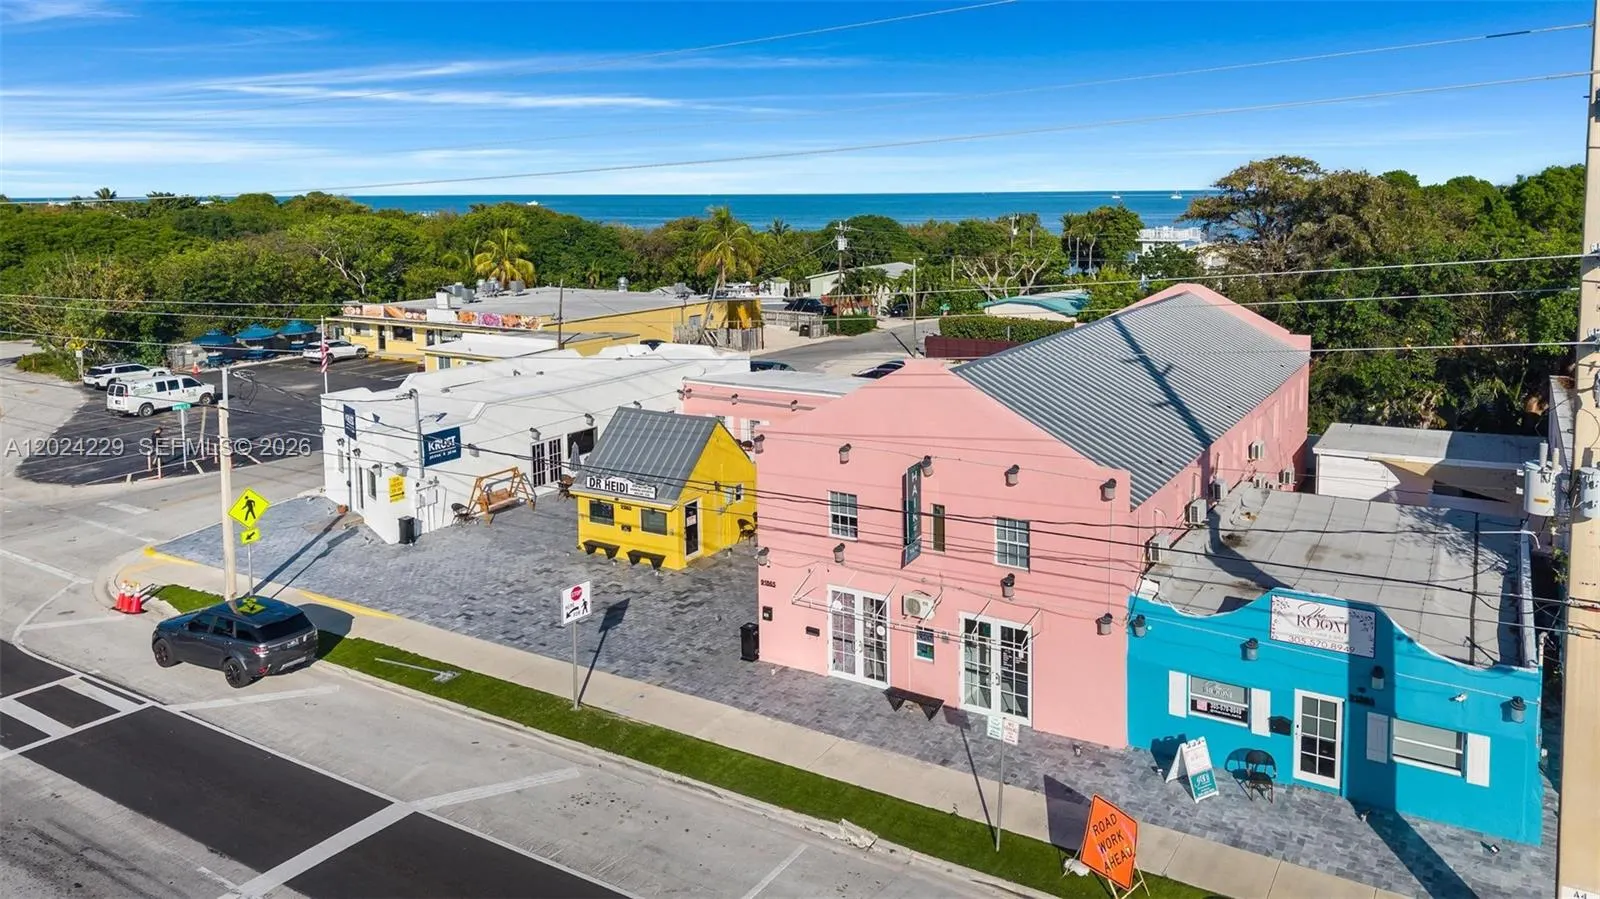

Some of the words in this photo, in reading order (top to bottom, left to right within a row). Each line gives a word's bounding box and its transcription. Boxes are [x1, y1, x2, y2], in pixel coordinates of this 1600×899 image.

[428, 436, 456, 451] KRUST
[589, 477, 602, 489] DR
[604, 479, 629, 494] HEIDI
[1296, 614, 1348, 634] ROOM
[1287, 634, 1307, 645] 305
[1310, 639, 1329, 649] 570
[1092, 813, 1118, 837] ROAD
[1098, 829, 1124, 854] WORK
[1104, 847, 1133, 874] AHEAD
